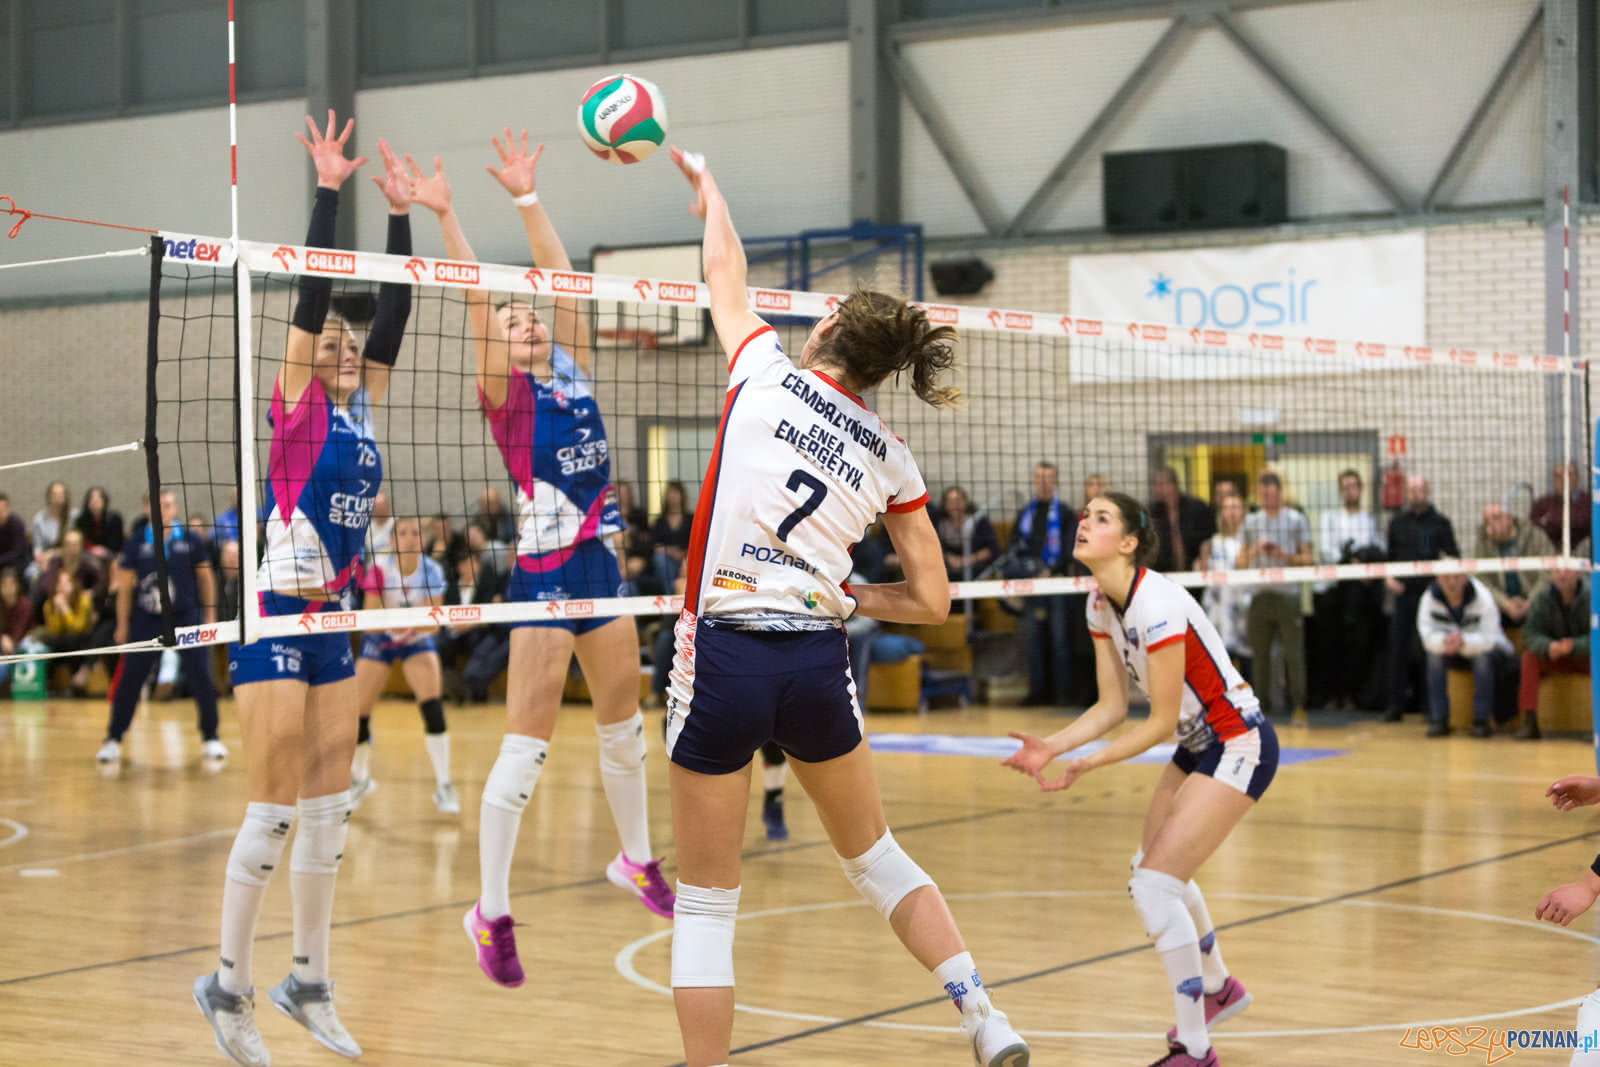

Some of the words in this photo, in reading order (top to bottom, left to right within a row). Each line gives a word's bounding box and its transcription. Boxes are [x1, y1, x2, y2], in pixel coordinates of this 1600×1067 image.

[163, 238, 222, 262] netex
[306, 251, 355, 273] ORLEN
[435, 262, 480, 284] ORLEN
[553, 274, 592, 293] ORLEN
[659, 283, 697, 302] ORLEN
[757, 292, 791, 309] ORLEN
[781, 373, 887, 462] CEMBRZYŃSKA
[808, 424, 845, 457] ENEA
[774, 419, 864, 490] ENERGETYK
[776, 469, 827, 543] 7
[716, 568, 758, 585] AKROPOL
[449, 607, 481, 622] ORLEN
[565, 601, 594, 616] ORLEN
[321, 613, 357, 630] ORLEN
[176, 628, 218, 647] netex
